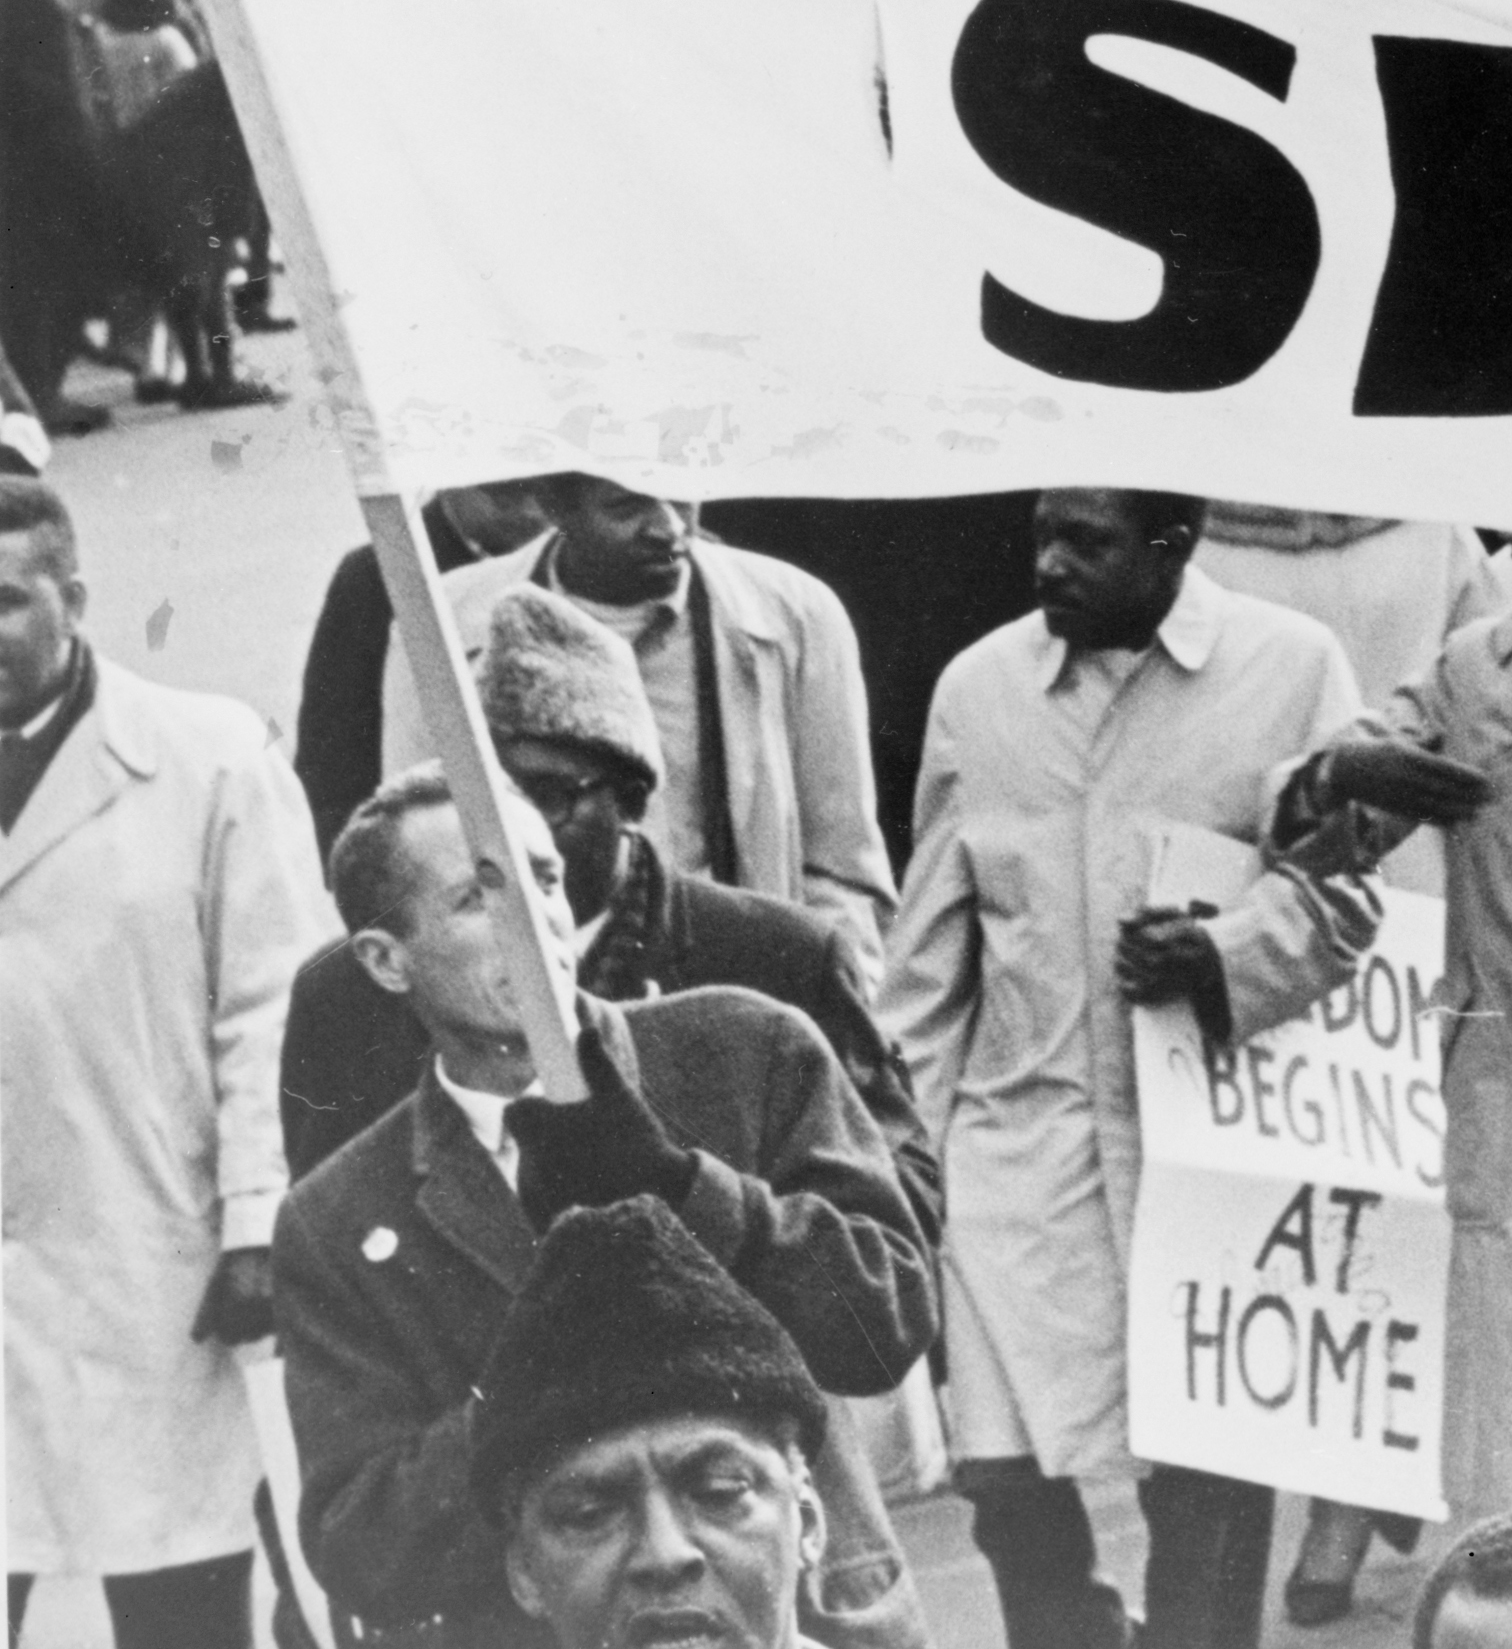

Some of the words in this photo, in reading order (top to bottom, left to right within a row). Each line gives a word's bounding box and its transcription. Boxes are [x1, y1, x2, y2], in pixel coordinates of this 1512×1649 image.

[1204, 1045, 1446, 1189] BEGINS
[1253, 1182, 1383, 1294] AT
[1184, 1279, 1421, 1454] HOME
